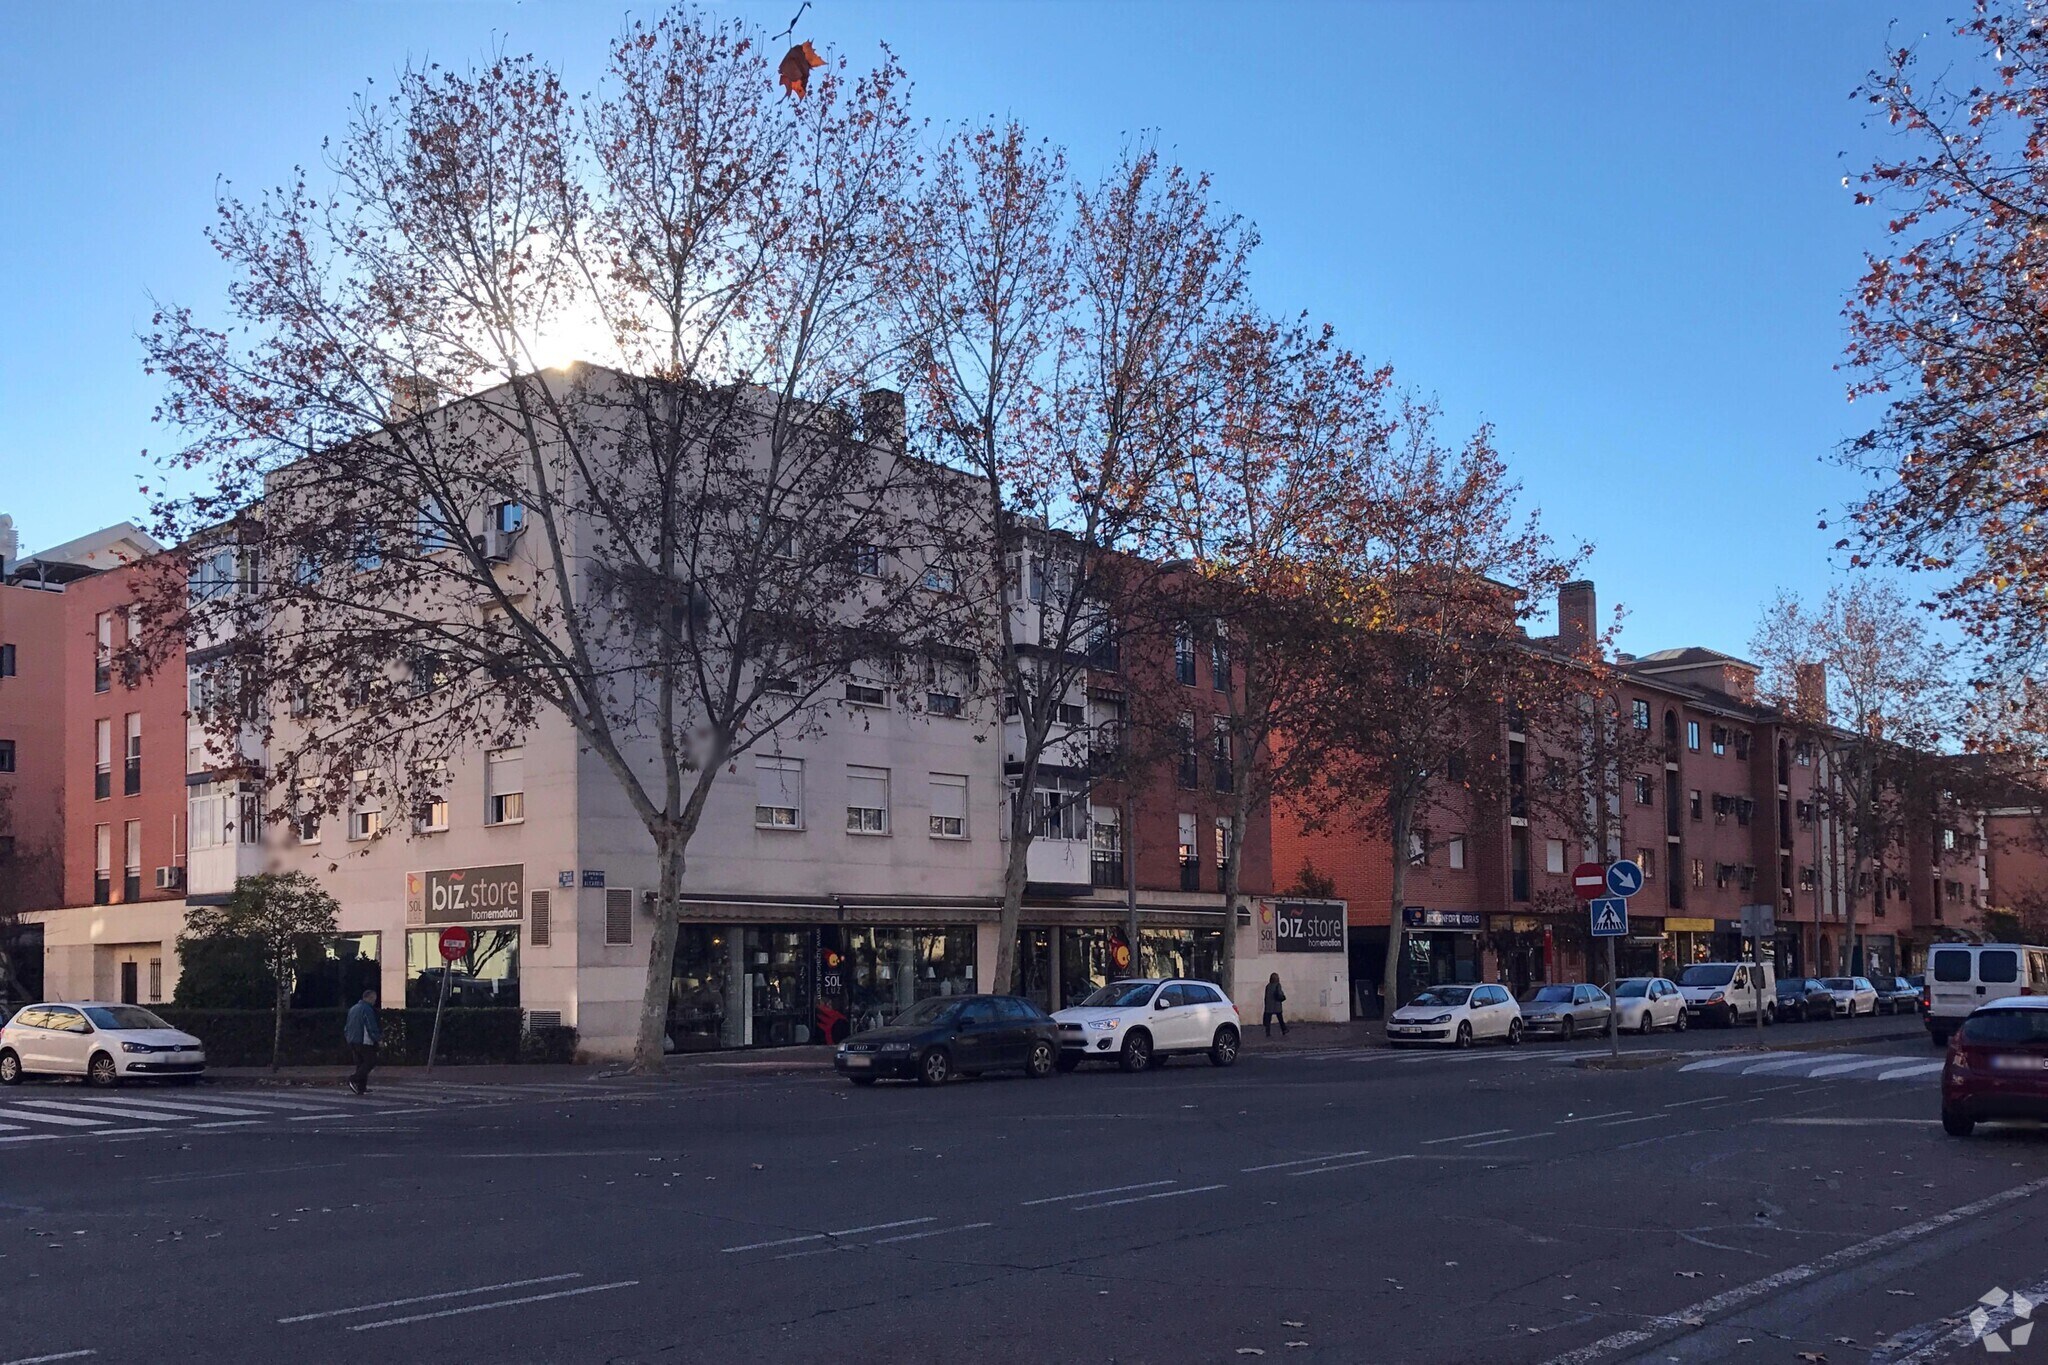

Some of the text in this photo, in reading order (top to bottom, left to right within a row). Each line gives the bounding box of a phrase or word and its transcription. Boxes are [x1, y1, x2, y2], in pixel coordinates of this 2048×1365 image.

[432, 873, 519, 911] biz.store
[408, 900, 423, 913] SOL
[471, 907, 518, 920] homemotion
[1461, 914, 1480, 924] OBRAS
[1277, 909, 1341, 938] biz.store
[1261, 929, 1274, 941] SOL
[1308, 938, 1342, 947] homemotion
[824, 975, 842, 987] SOL
